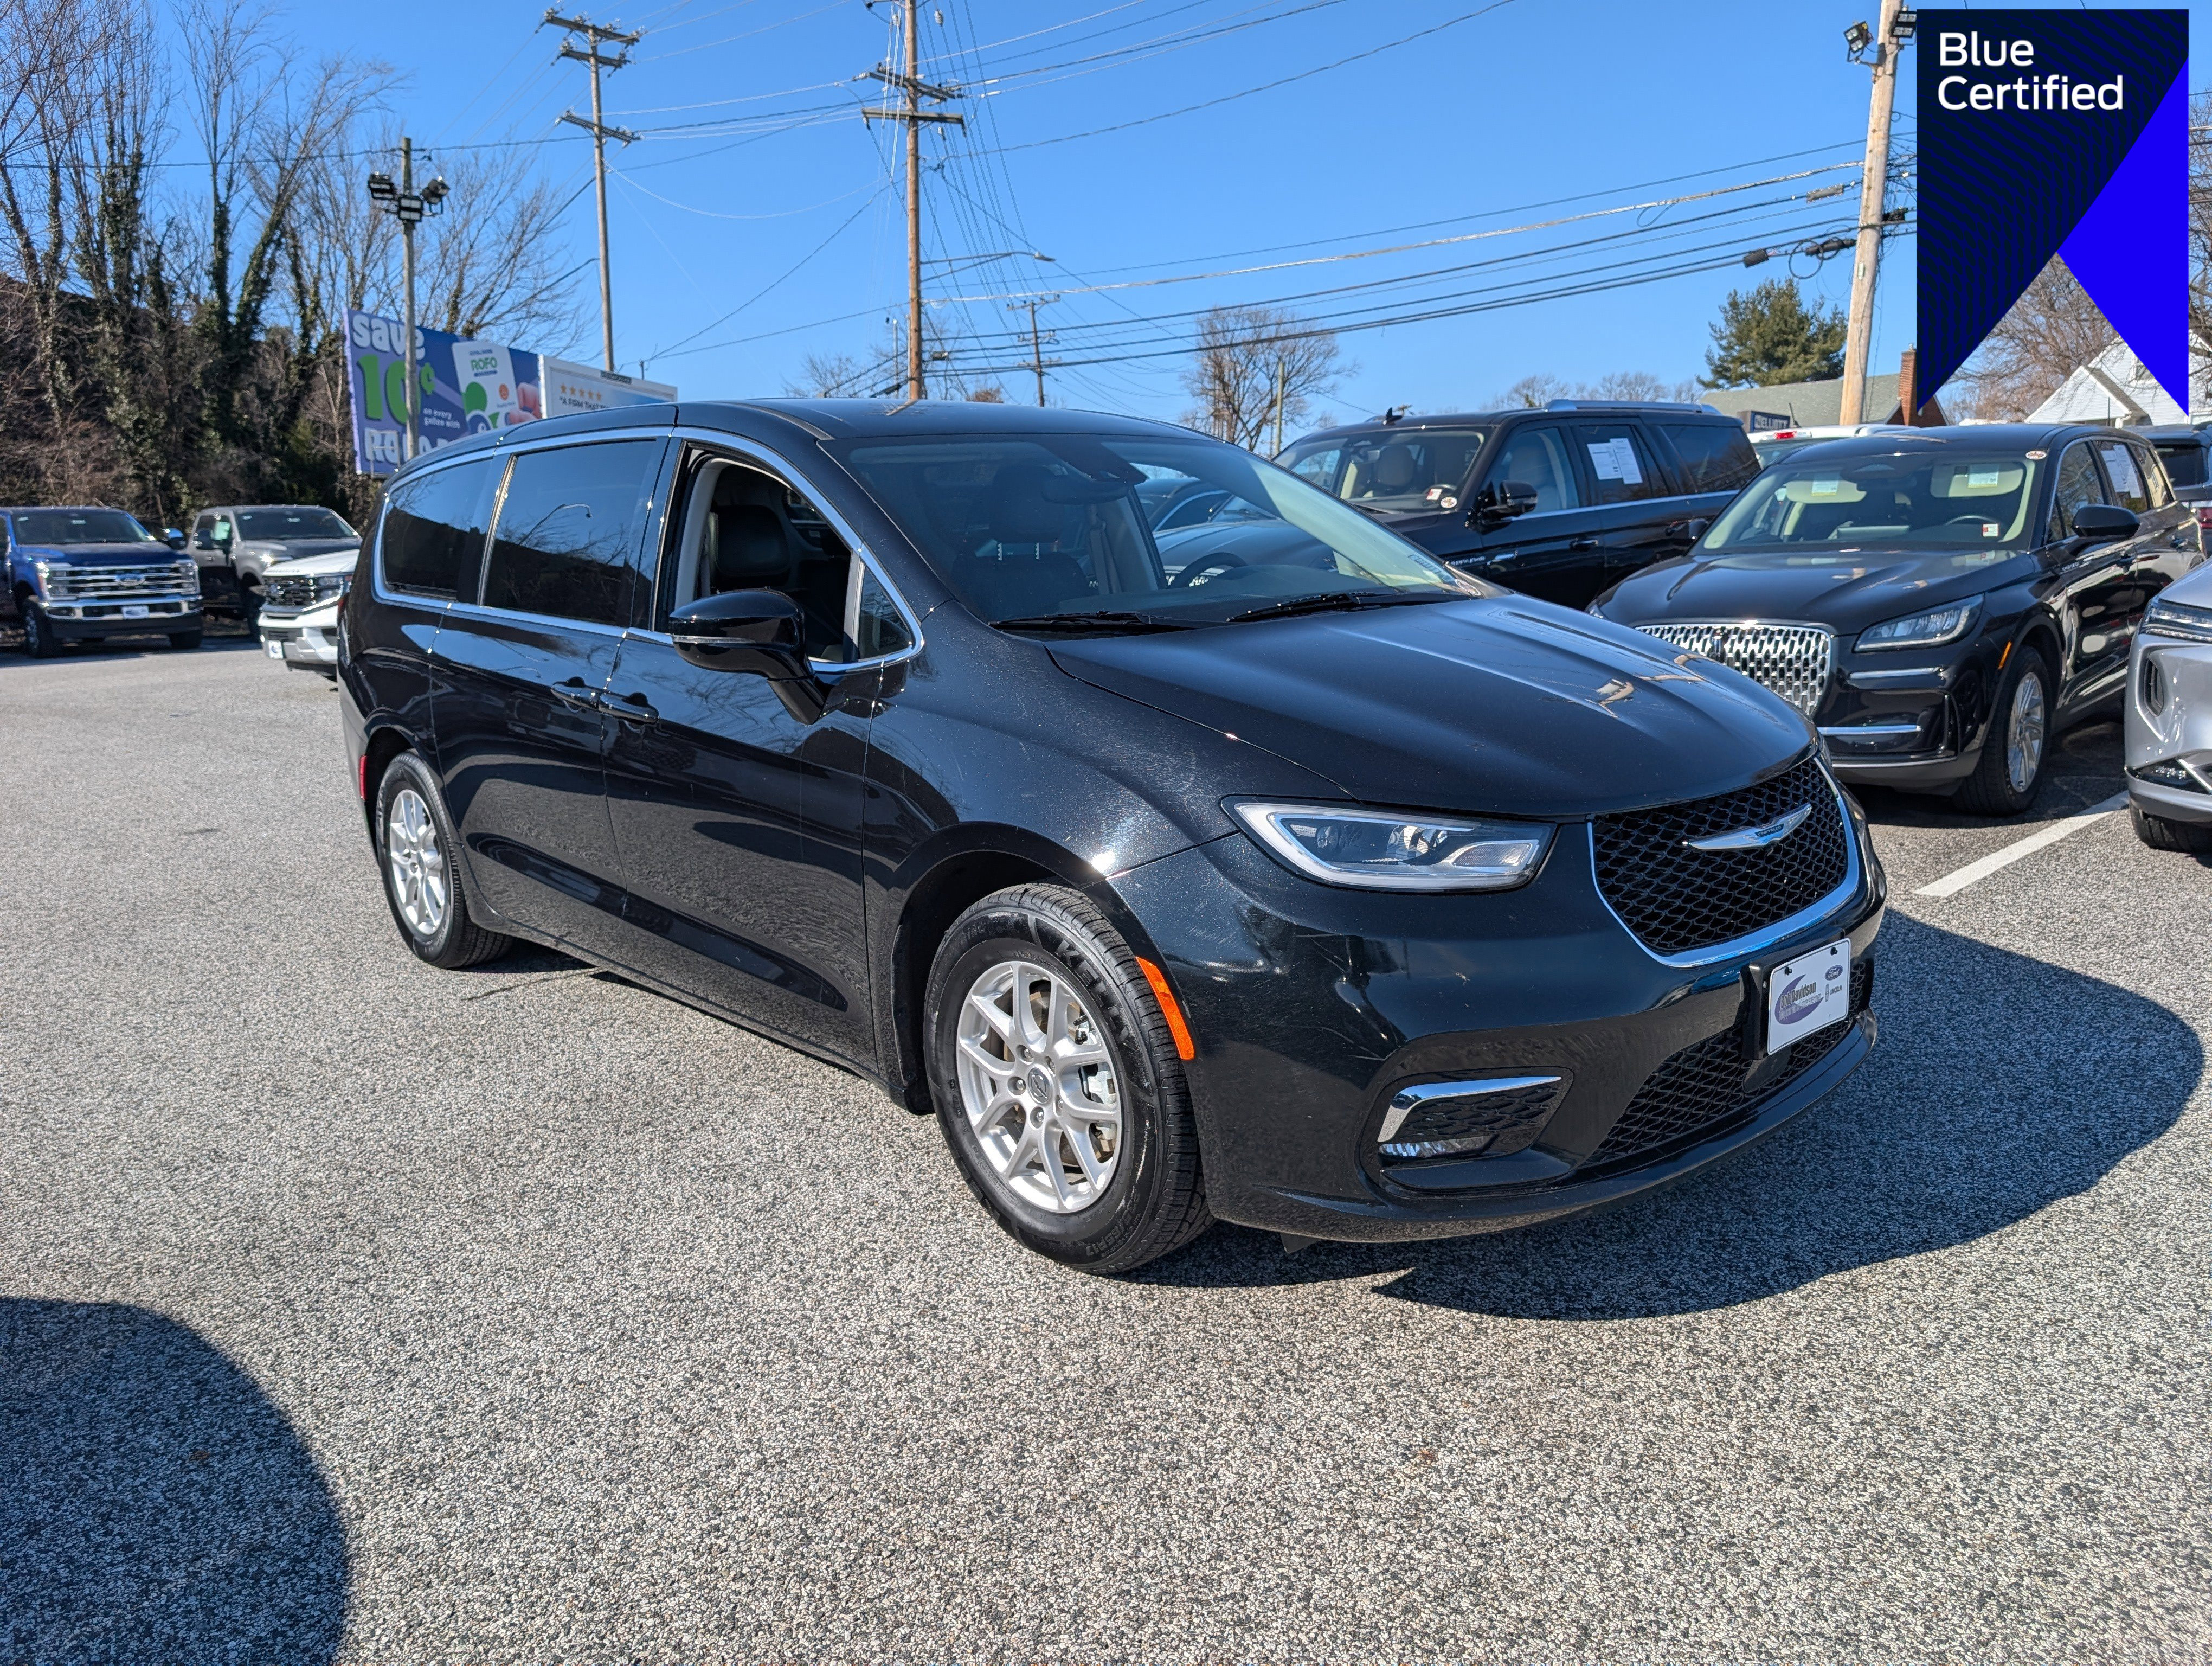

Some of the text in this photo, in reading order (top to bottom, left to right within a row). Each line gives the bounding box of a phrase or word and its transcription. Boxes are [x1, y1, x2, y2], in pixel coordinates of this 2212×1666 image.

[352, 313, 426, 360] save
[470, 357, 498, 371] ROFO
[1054, 939, 1140, 1052] KELLY
[1780, 991, 1792, 1009] Bob
[1791, 982, 1816, 1004] Davidson
